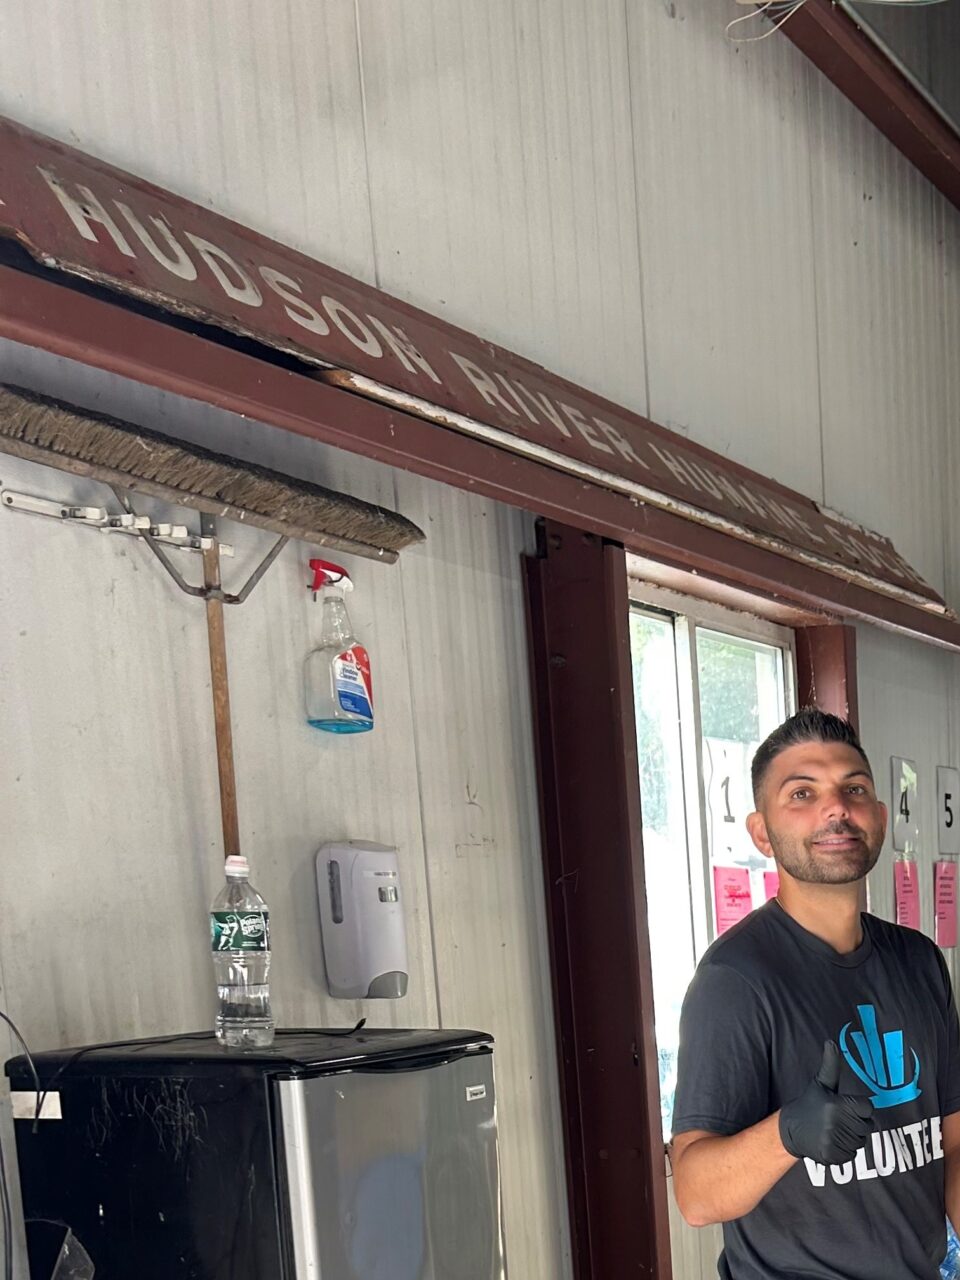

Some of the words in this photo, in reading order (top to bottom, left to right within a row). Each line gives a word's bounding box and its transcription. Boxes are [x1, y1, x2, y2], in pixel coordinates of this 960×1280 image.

[37, 164, 442, 385] HUDSON
[448, 351, 651, 471] RIVER
[647, 442, 827, 544] HUMANE
[720, 776, 736, 823] 1
[899, 786, 911, 824] 4
[944, 793, 954, 828] 5
[802, 1115, 945, 1188] VOLUNTEE
